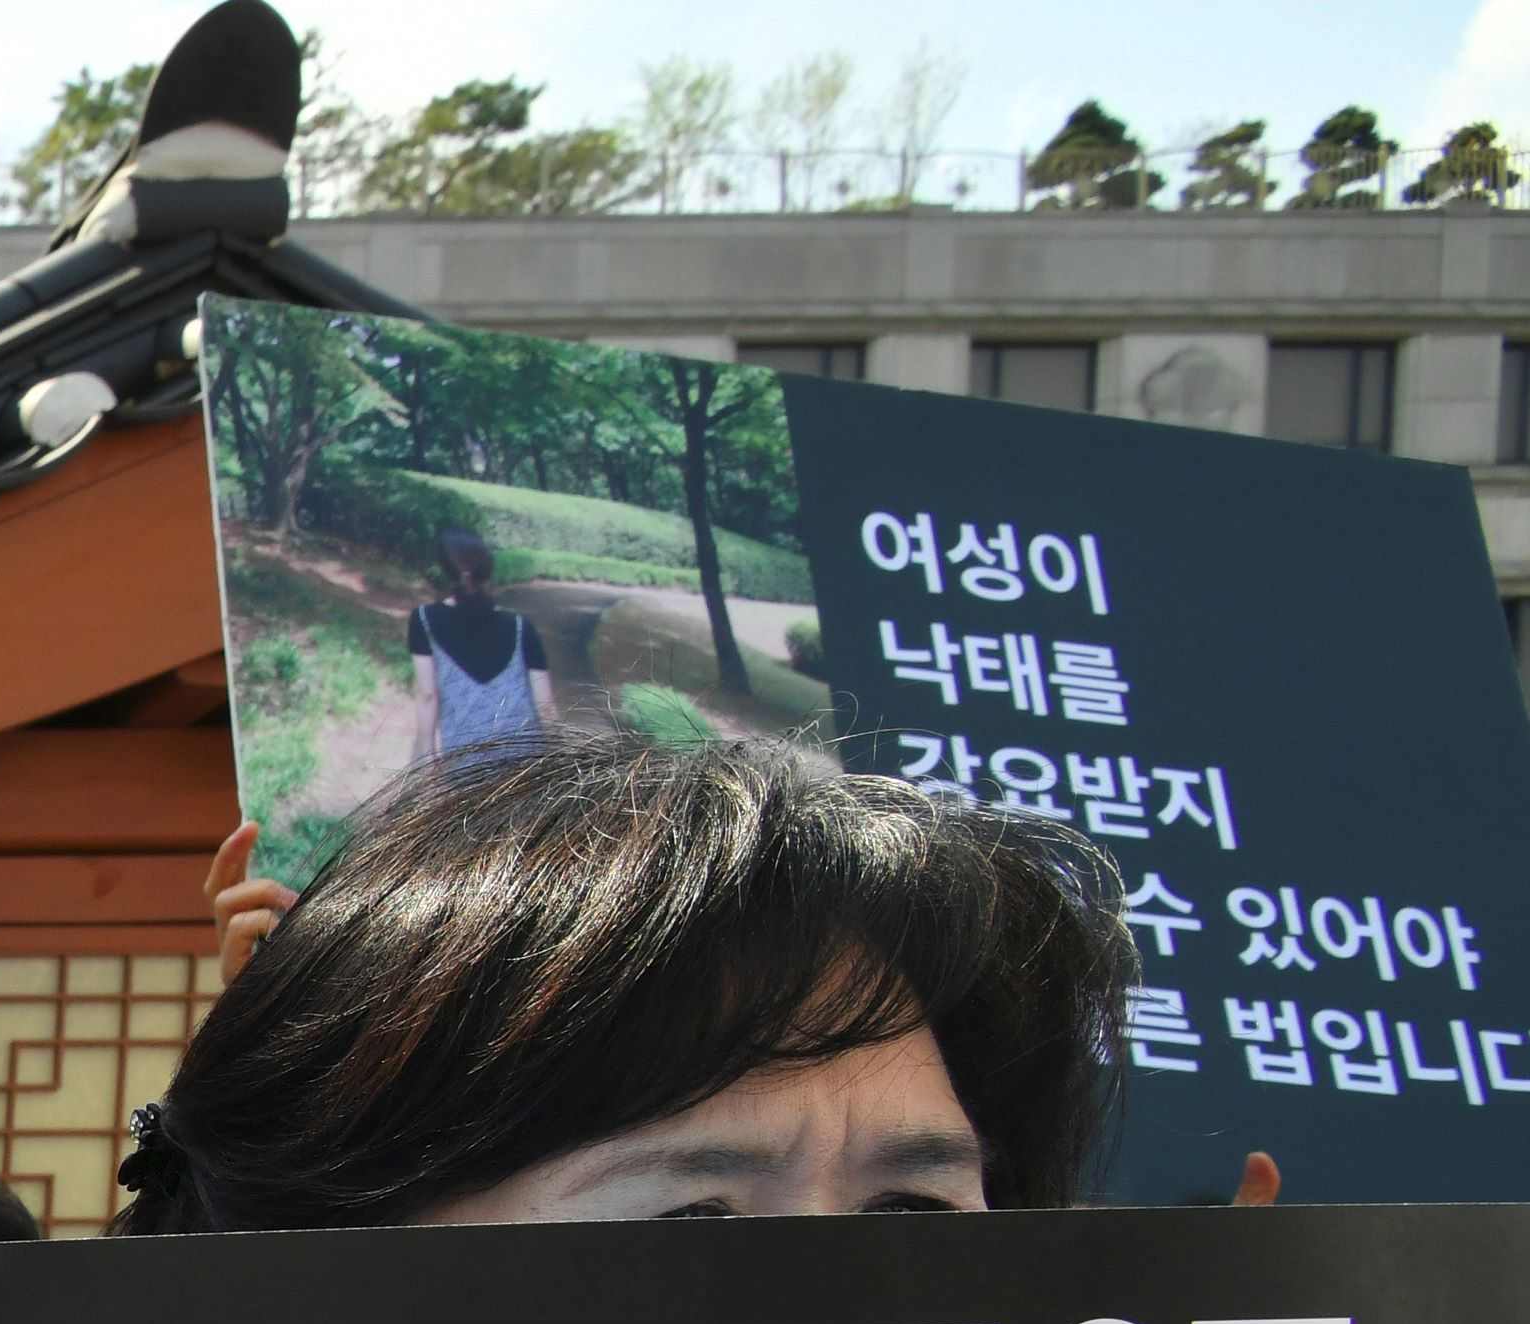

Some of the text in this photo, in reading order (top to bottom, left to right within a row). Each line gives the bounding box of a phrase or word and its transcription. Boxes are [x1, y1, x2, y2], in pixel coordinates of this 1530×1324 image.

[861, 510, 1110, 615] 여성이
[878, 618, 1131, 727] 낙태를
[898, 733, 1239, 850] 강요받지
[1124, 872, 1481, 991] 수 있어야
